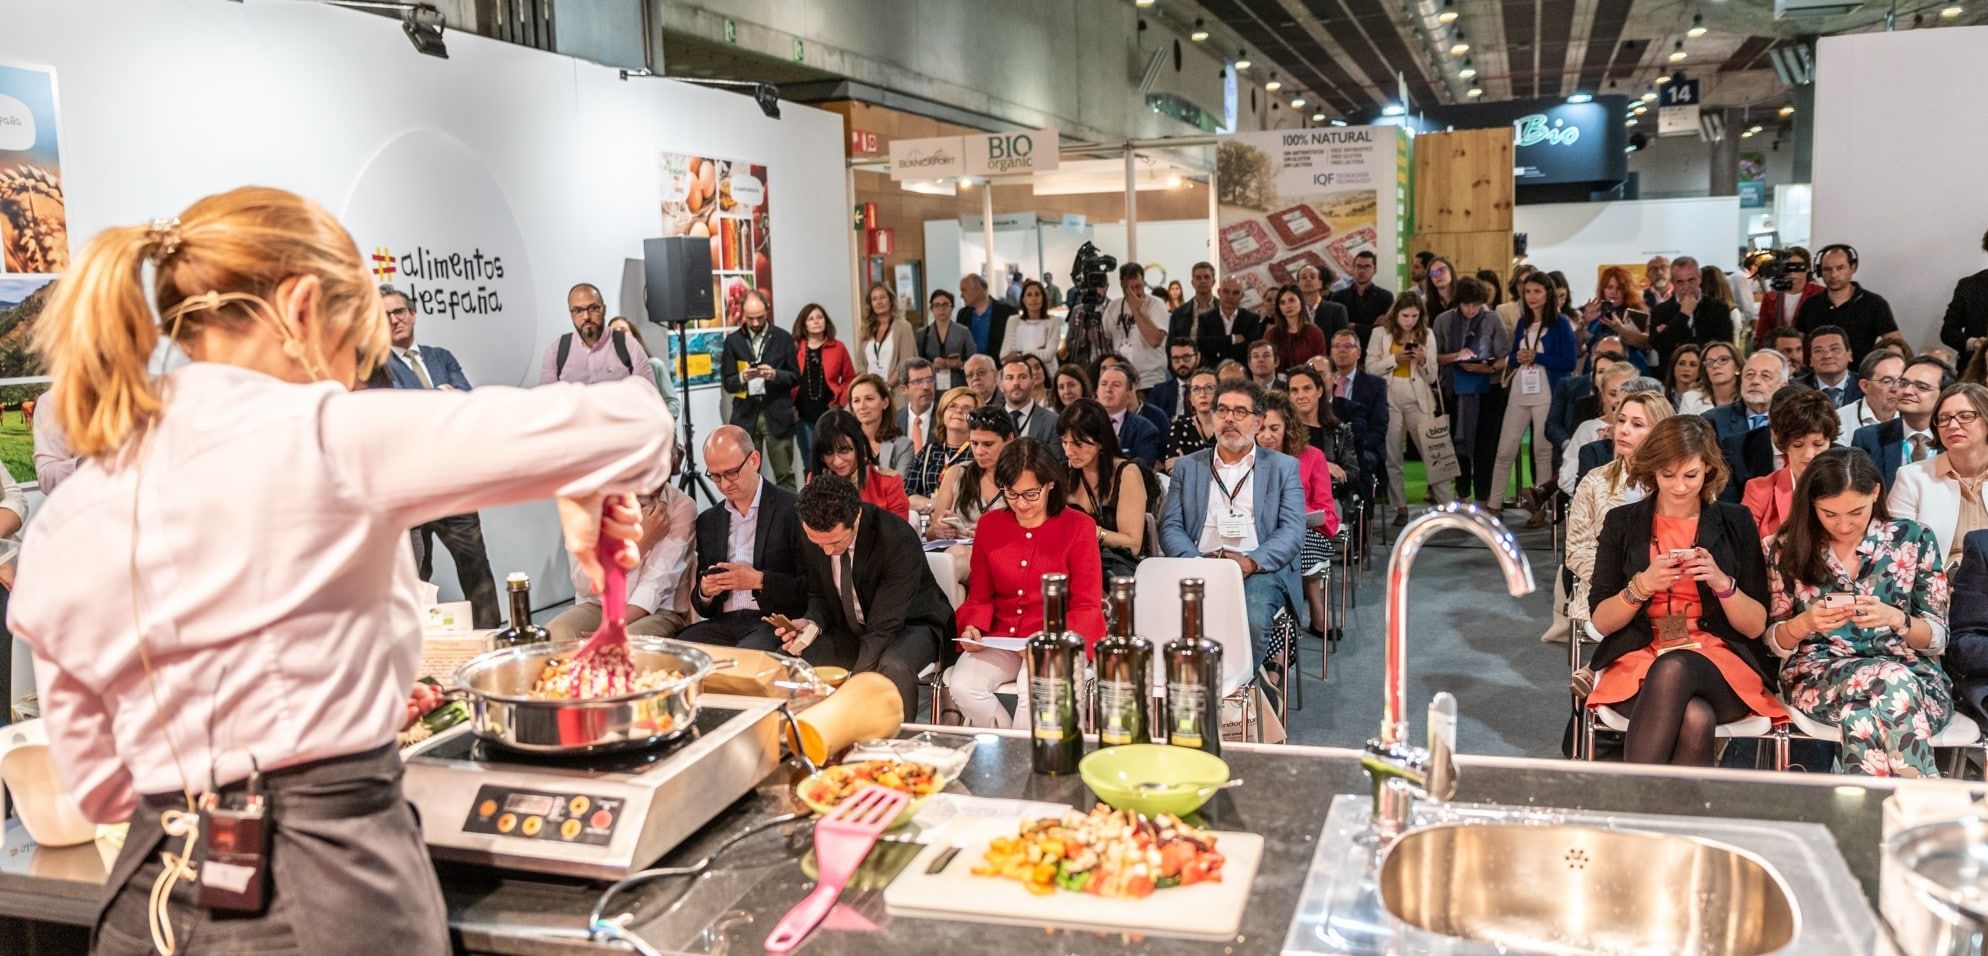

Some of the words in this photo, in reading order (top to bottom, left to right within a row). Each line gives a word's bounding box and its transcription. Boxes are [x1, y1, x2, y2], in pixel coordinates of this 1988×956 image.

[1667, 84, 1692, 103] 14
[1283, 134, 1309, 146] 100%
[1311, 131, 1372, 145] NATURAL
[1519, 113, 1580, 146] Bio
[988, 134, 1033, 159] BIO
[988, 156, 1033, 173] organic
[1313, 173, 1335, 187] IQF
